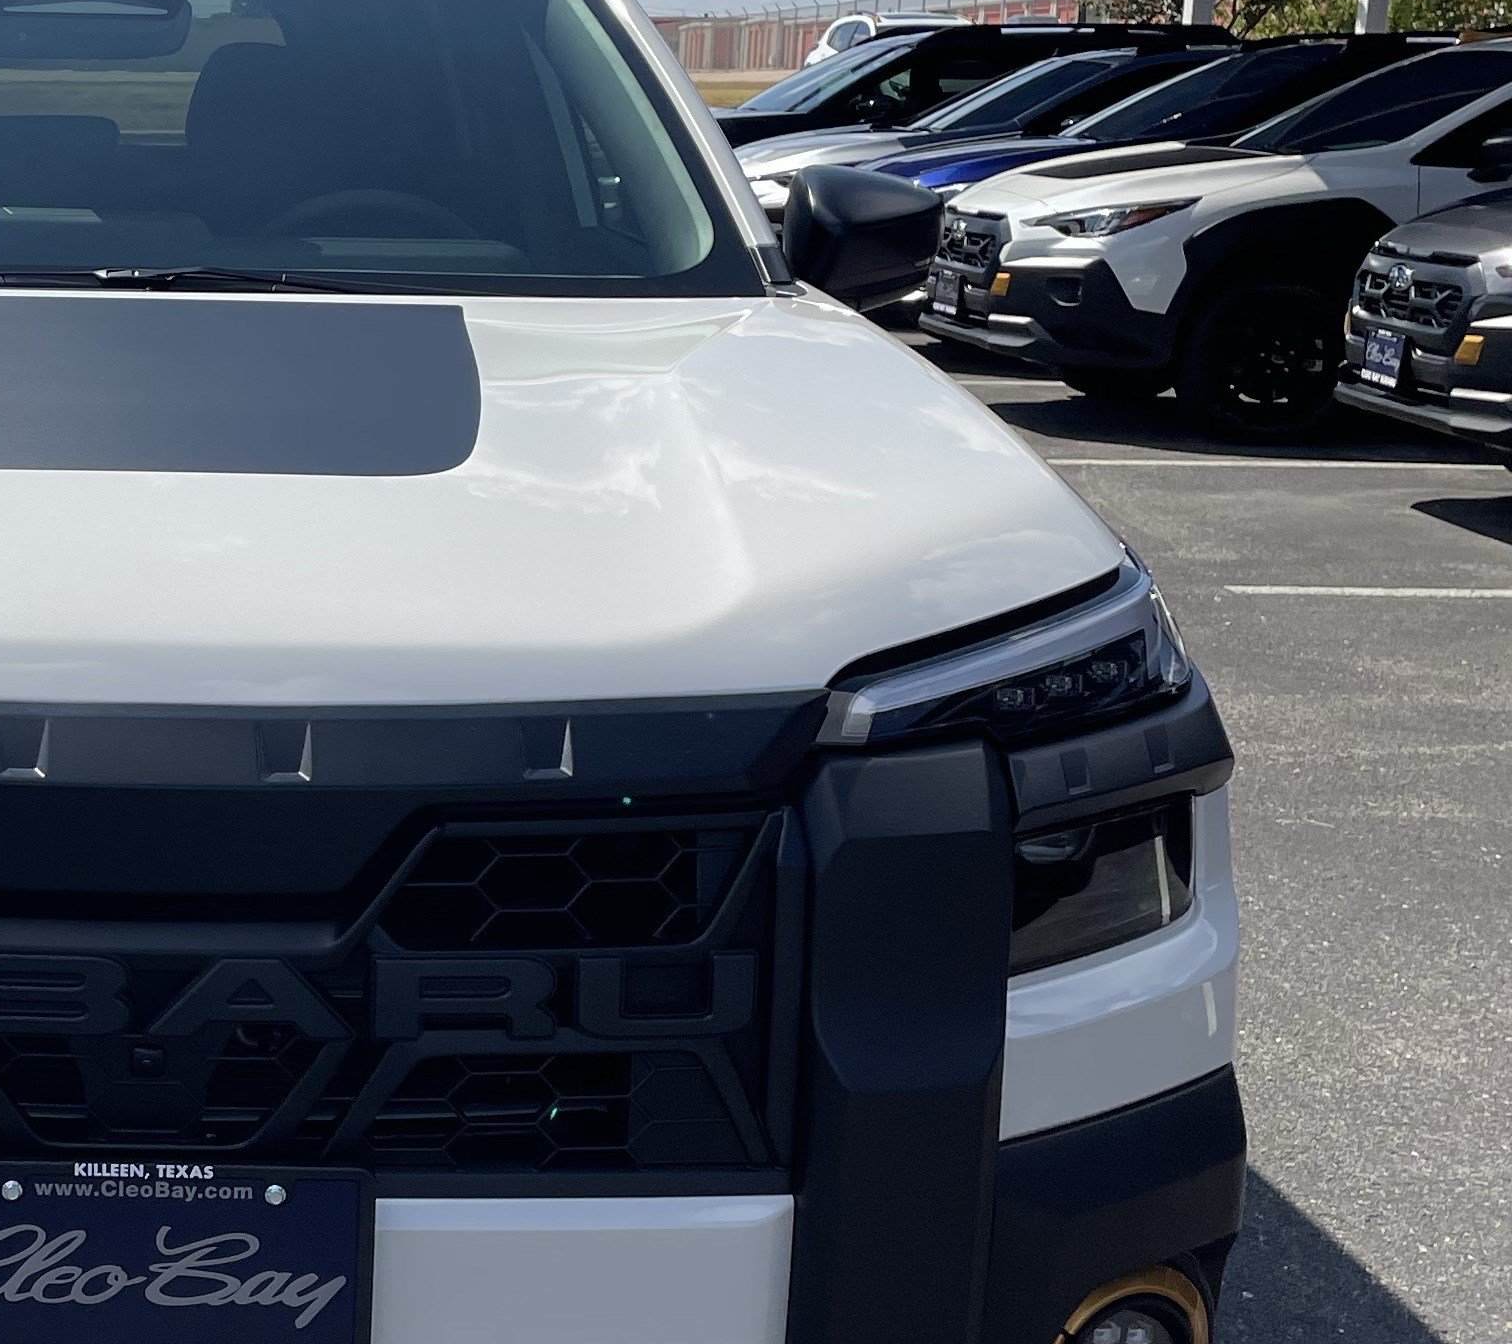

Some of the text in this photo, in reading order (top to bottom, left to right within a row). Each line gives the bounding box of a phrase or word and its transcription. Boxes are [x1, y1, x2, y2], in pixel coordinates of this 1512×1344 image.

[73, 1162, 214, 1180] KILLEEN, TEXAS
[34, 1179, 253, 1201] www.CleoBay.com
[144, 1225, 347, 1330] Bay
